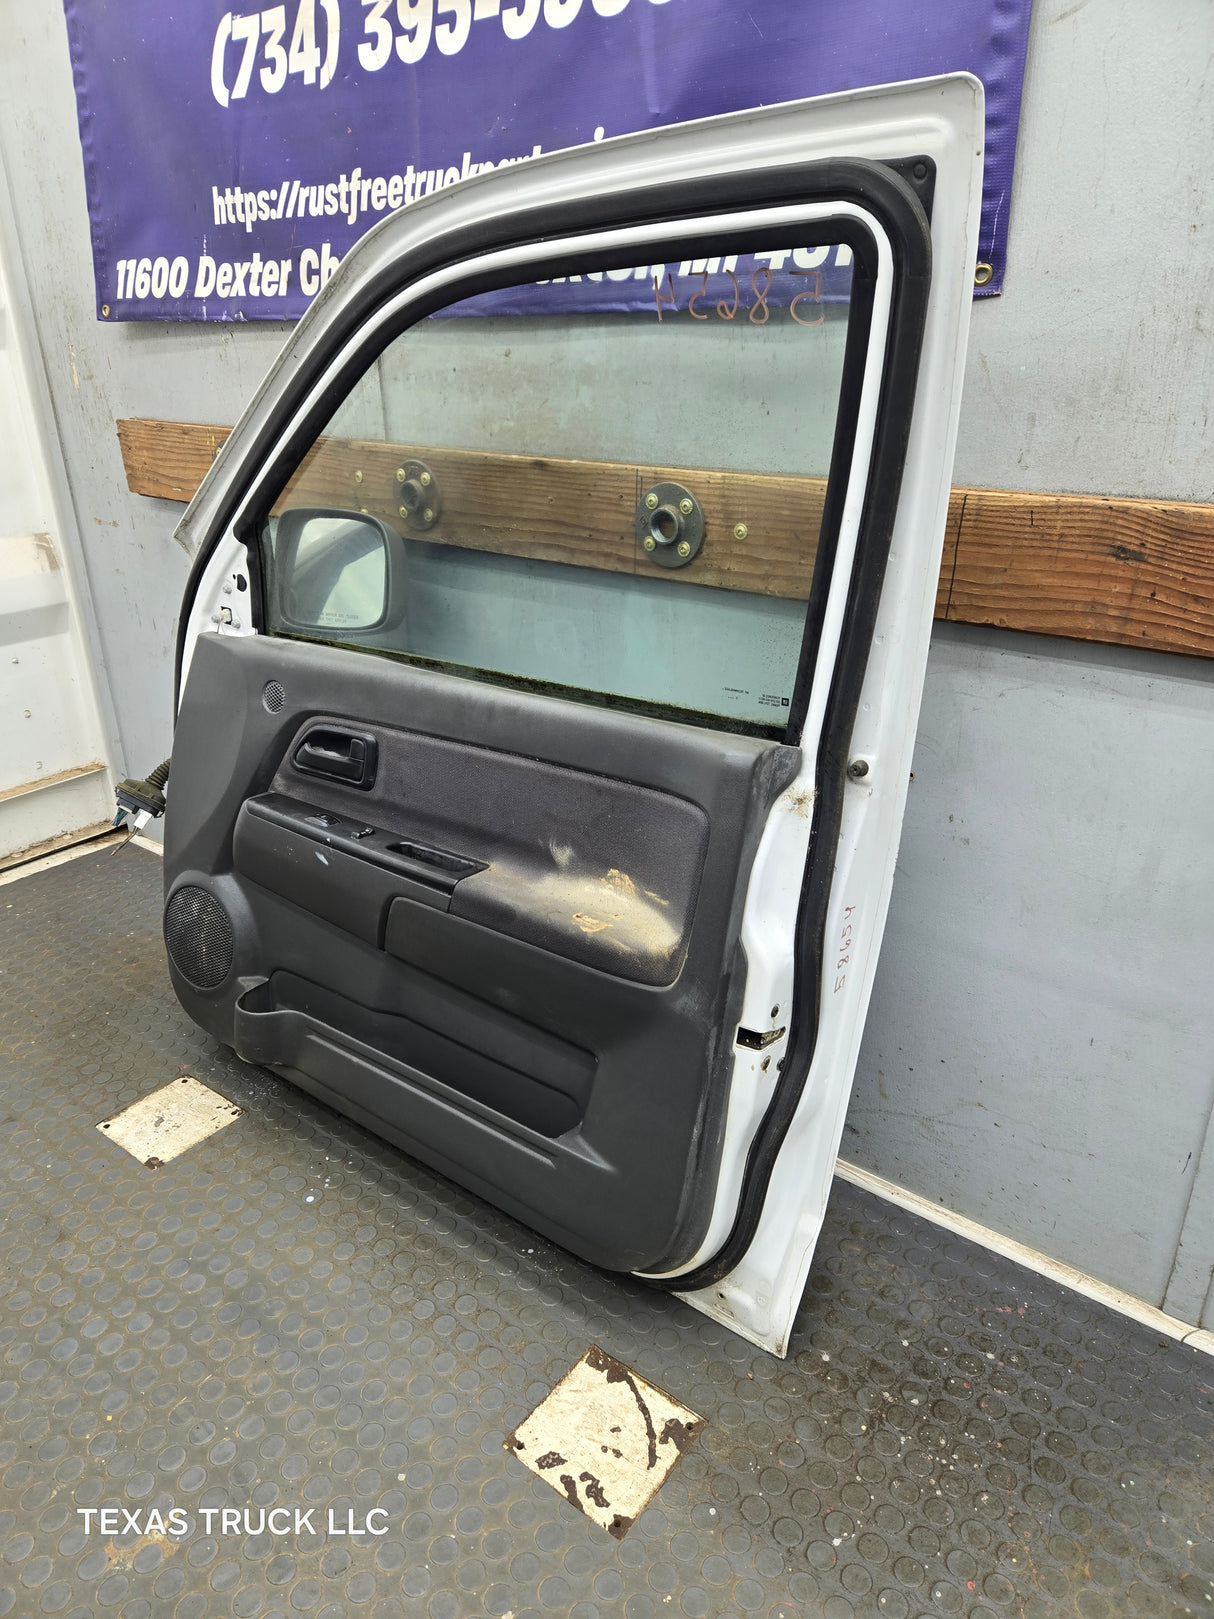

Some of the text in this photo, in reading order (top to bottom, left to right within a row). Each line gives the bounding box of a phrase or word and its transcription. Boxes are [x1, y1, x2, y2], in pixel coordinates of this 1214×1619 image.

[210, 0, 341, 108] (734)
[116, 243, 346, 299] 11600 Dexter Ch
[833, 905, 856, 993] 58654
